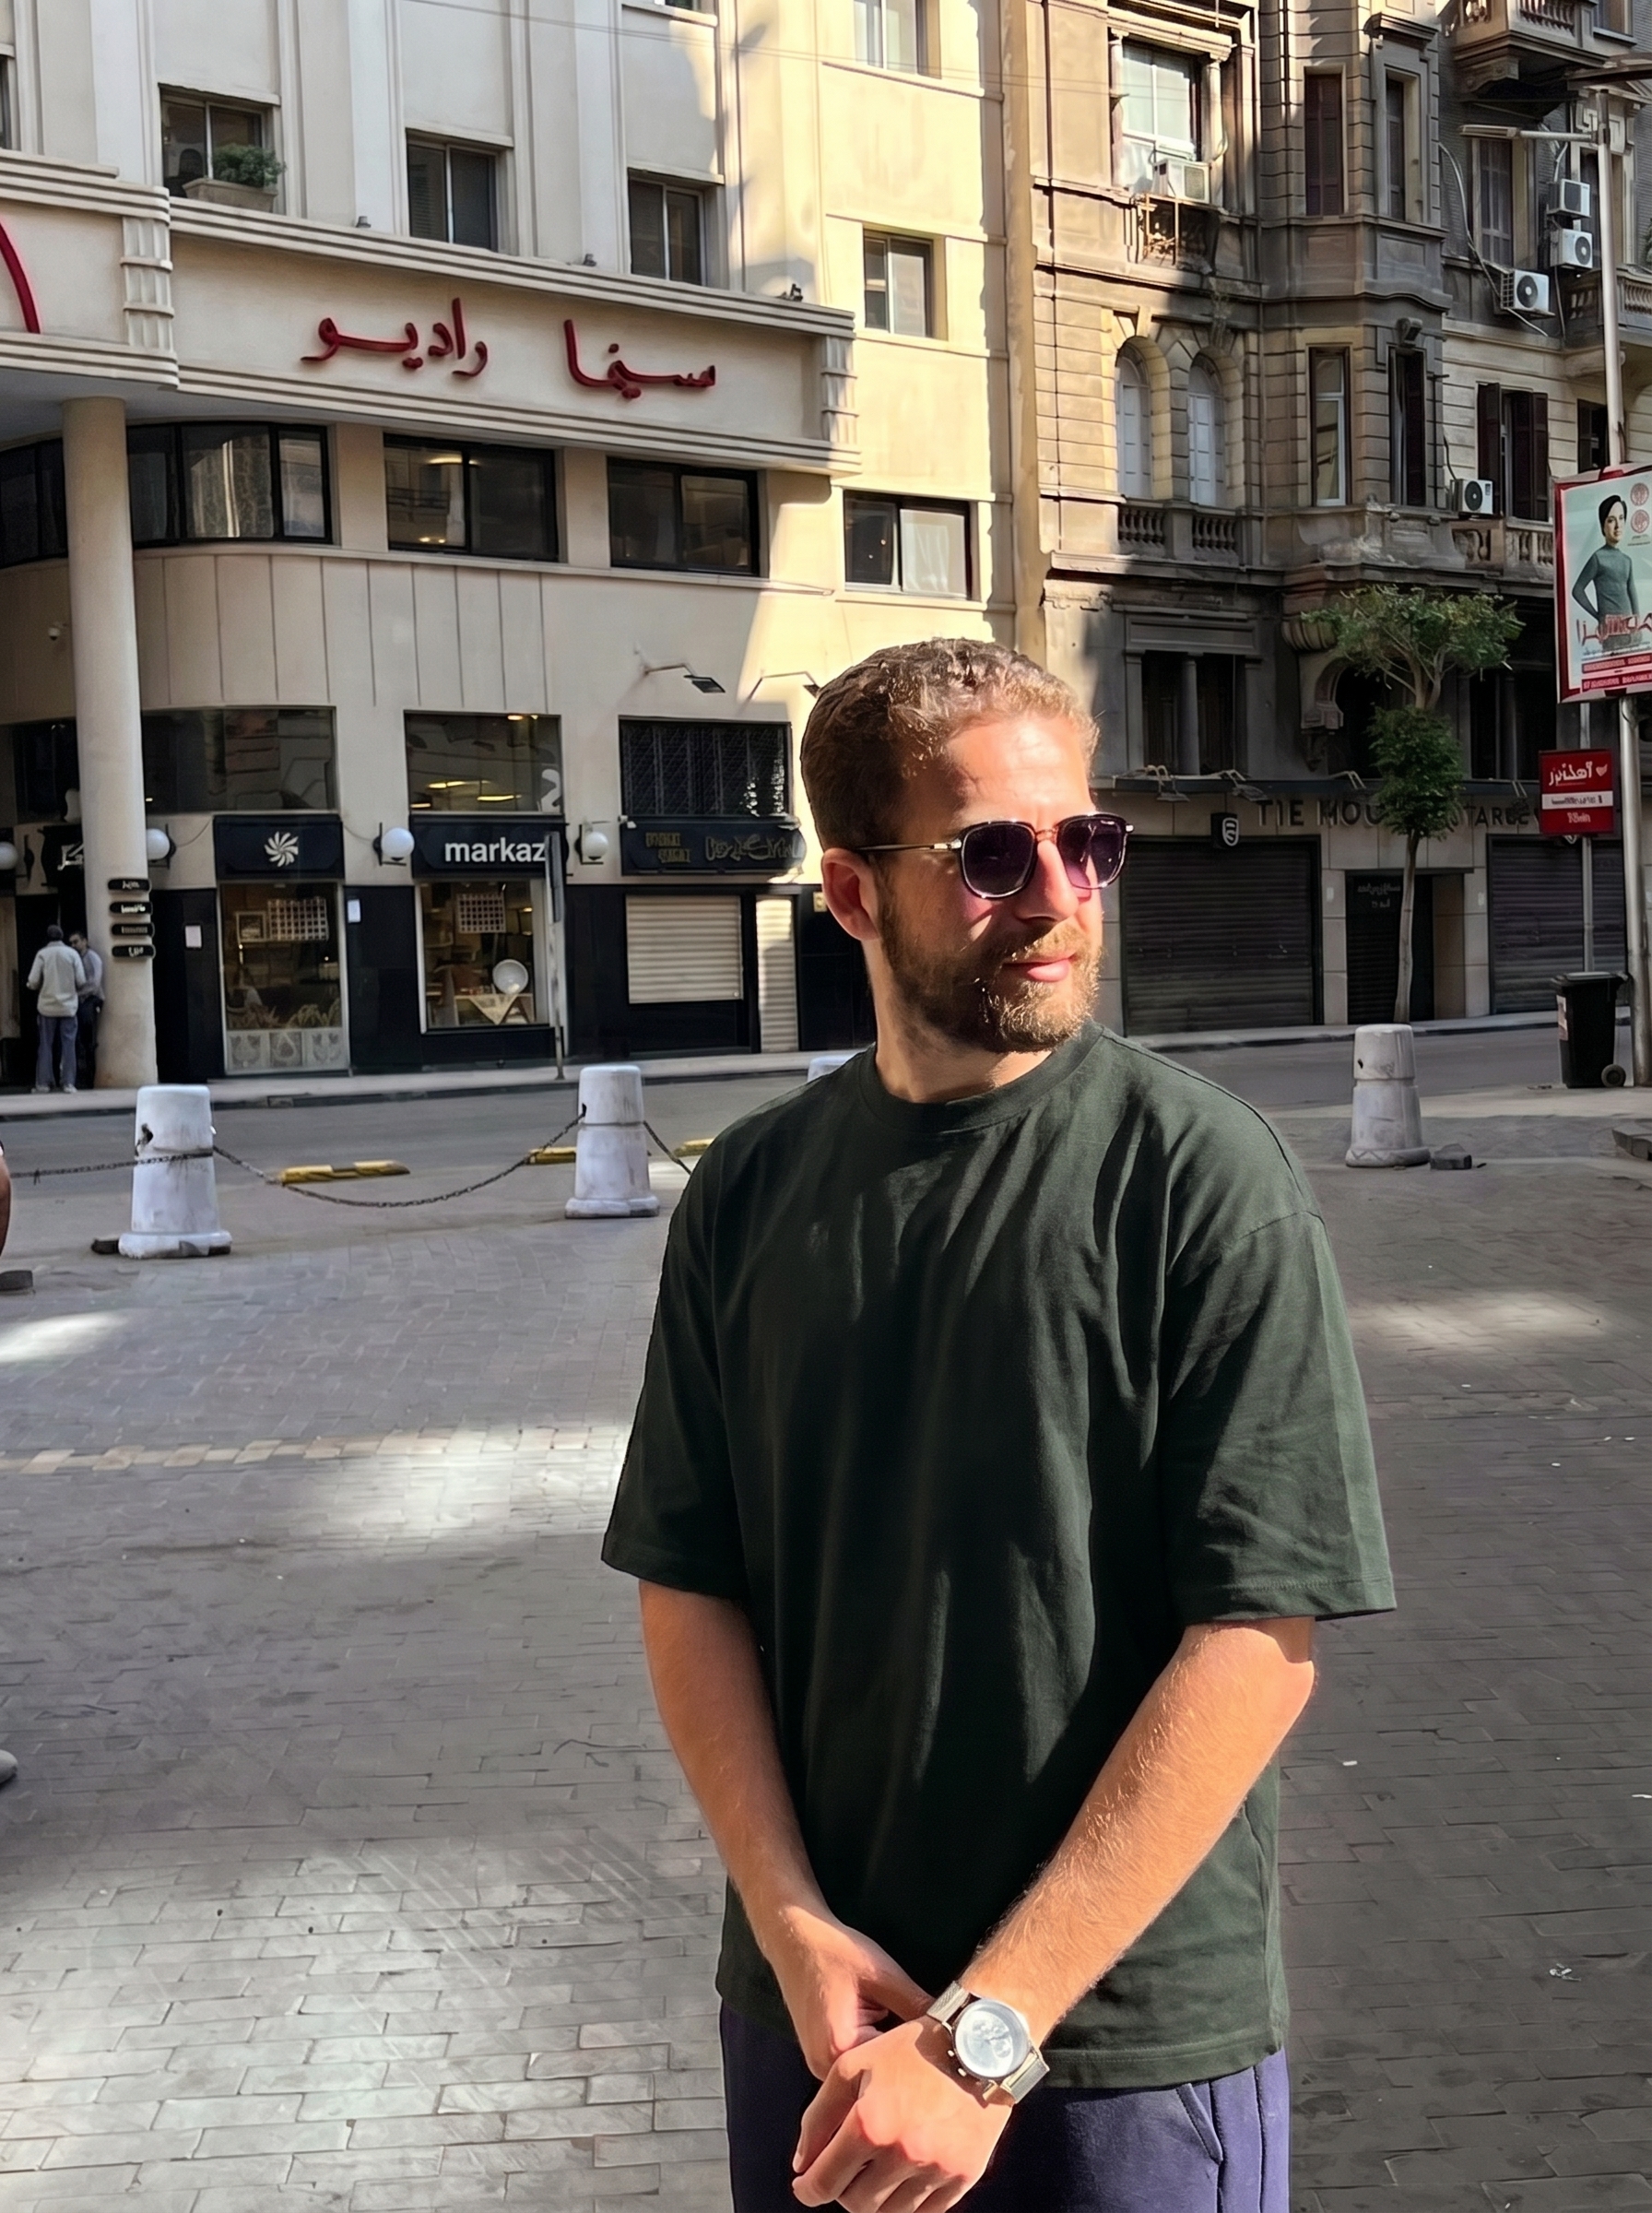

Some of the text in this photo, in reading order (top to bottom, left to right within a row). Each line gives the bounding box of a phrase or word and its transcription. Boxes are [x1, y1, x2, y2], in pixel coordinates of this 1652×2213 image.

[301, 297, 715, 398] سينما راديو
[444, 836, 546, 862] markaz
